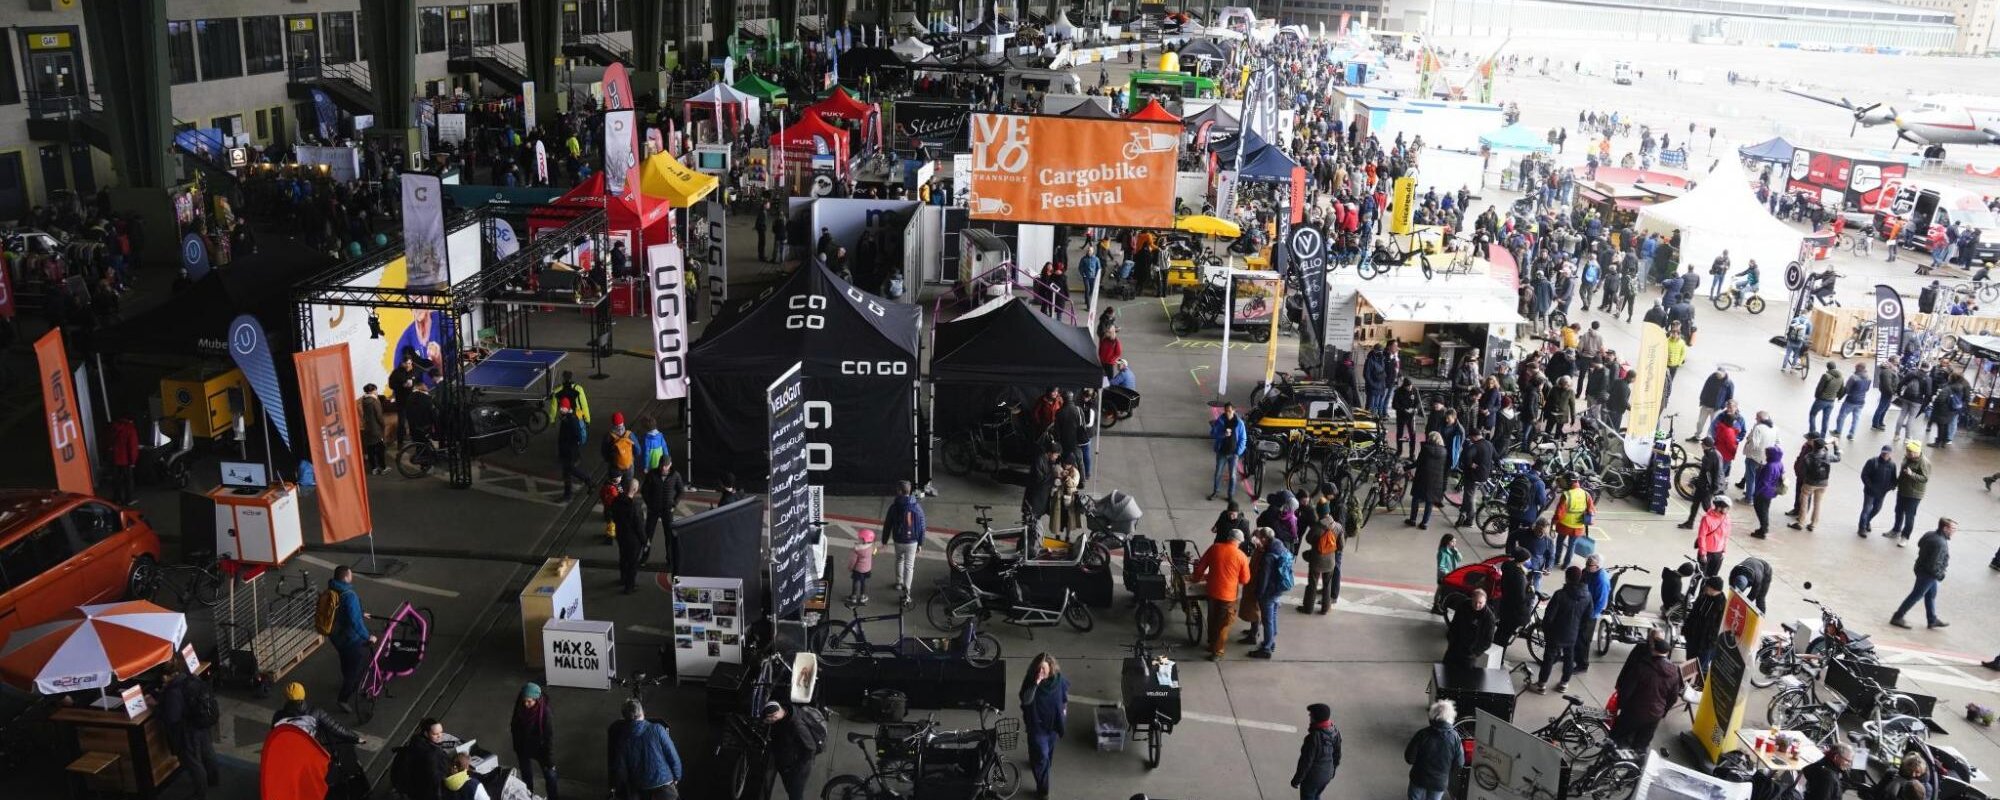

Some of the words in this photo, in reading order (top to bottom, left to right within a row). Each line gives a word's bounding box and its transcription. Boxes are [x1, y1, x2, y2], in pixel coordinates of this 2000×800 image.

[820, 110, 845, 118] PUKY
[792, 138, 814, 146] PUK
[973, 173, 1028, 184] TRANSPORT
[1039, 163, 1149, 188] Cargobike
[1040, 188, 1123, 211] Festival
[1298, 257, 1323, 271] VELLO
[785, 314, 826, 330] GO
[198, 338, 228, 350] Mube
[876, 360, 908, 376] GO
[771, 381, 802, 414] VELOGUT
[583, 638, 598, 658] &
[52, 673, 98, 688] e2trail
